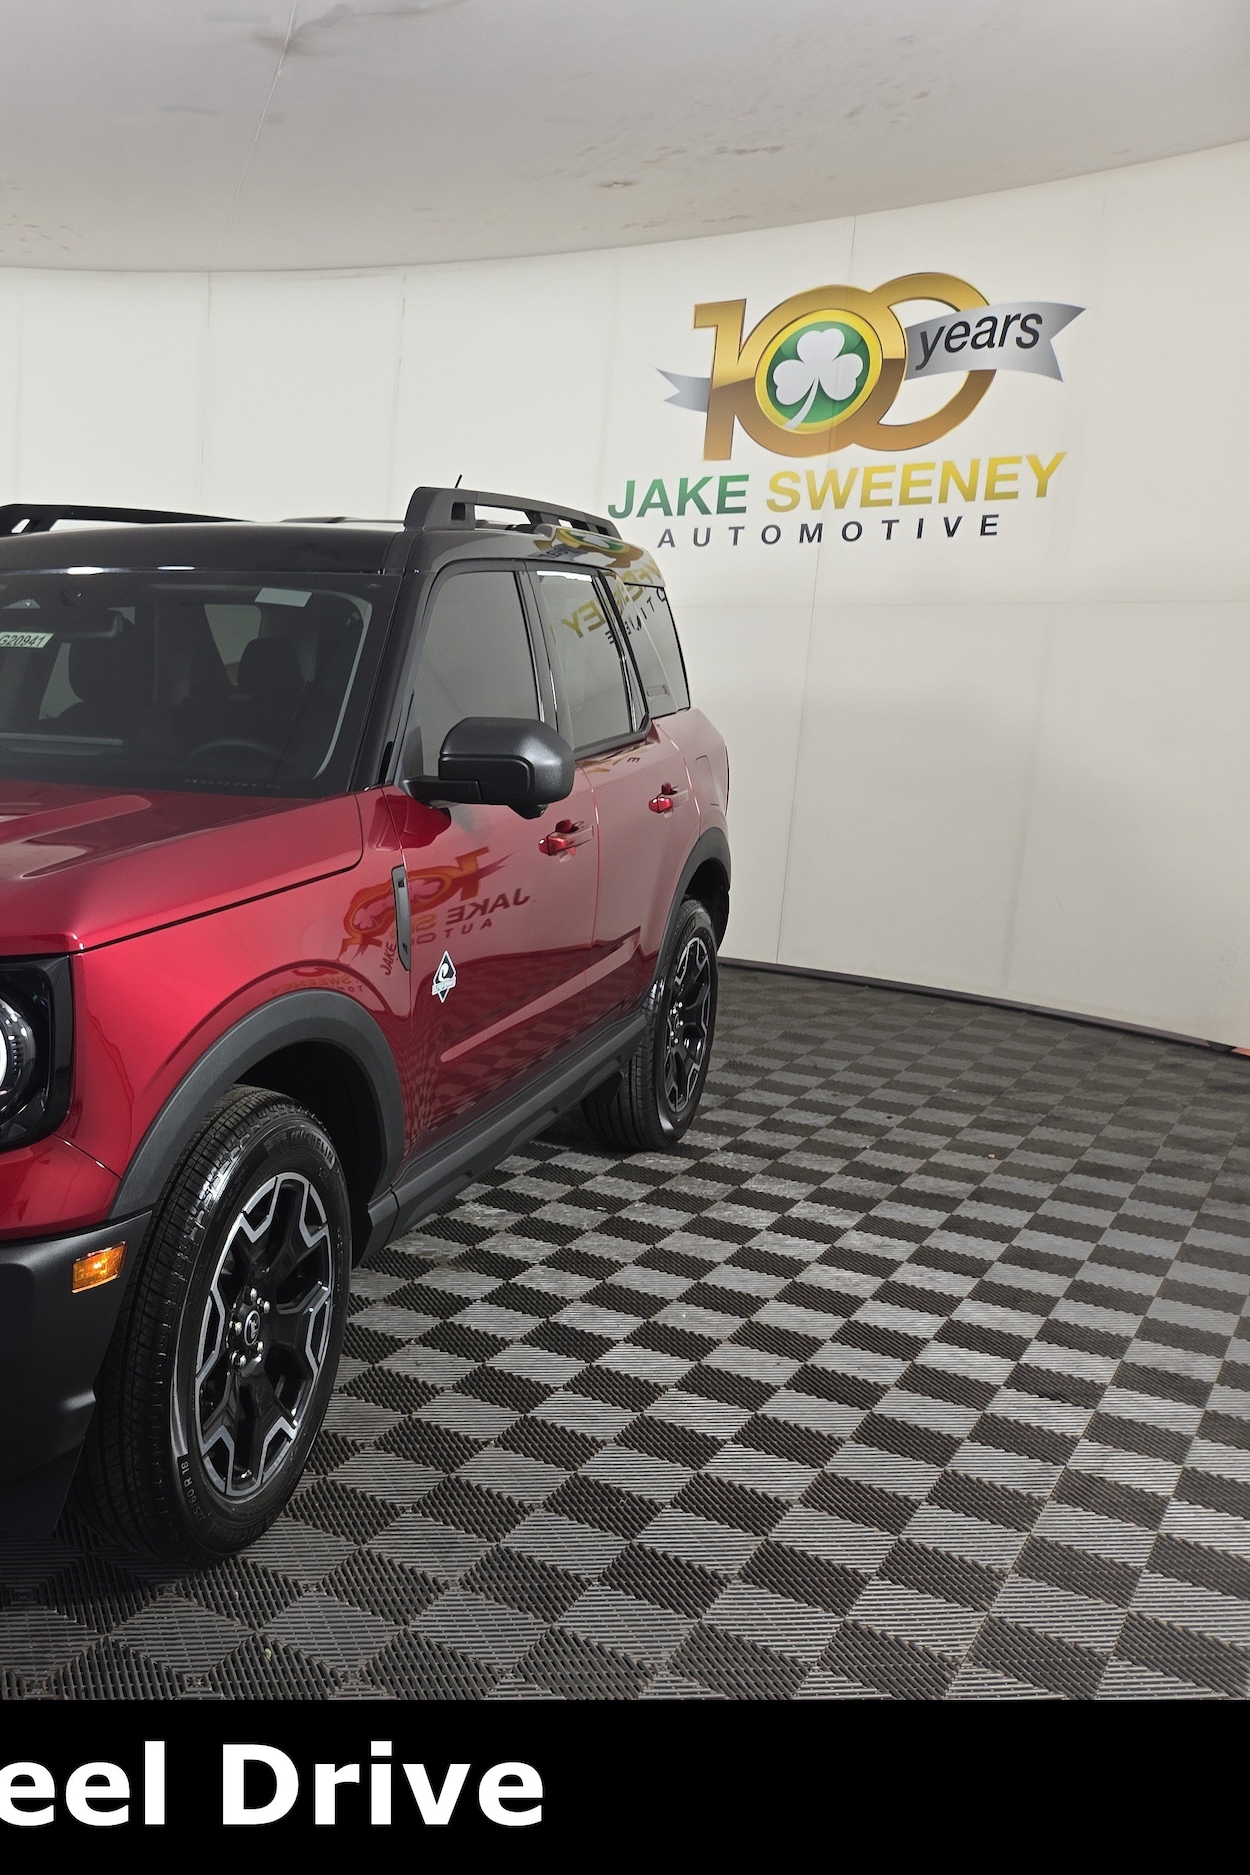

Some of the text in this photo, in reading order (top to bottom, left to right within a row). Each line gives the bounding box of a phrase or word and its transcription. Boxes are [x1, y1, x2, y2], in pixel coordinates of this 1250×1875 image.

[694, 272, 997, 461] 100
[915, 311, 1043, 371] years
[607, 452, 1068, 519] JAKE SWEENEY
[657, 514, 1000, 549] AUTOMOTIVE
